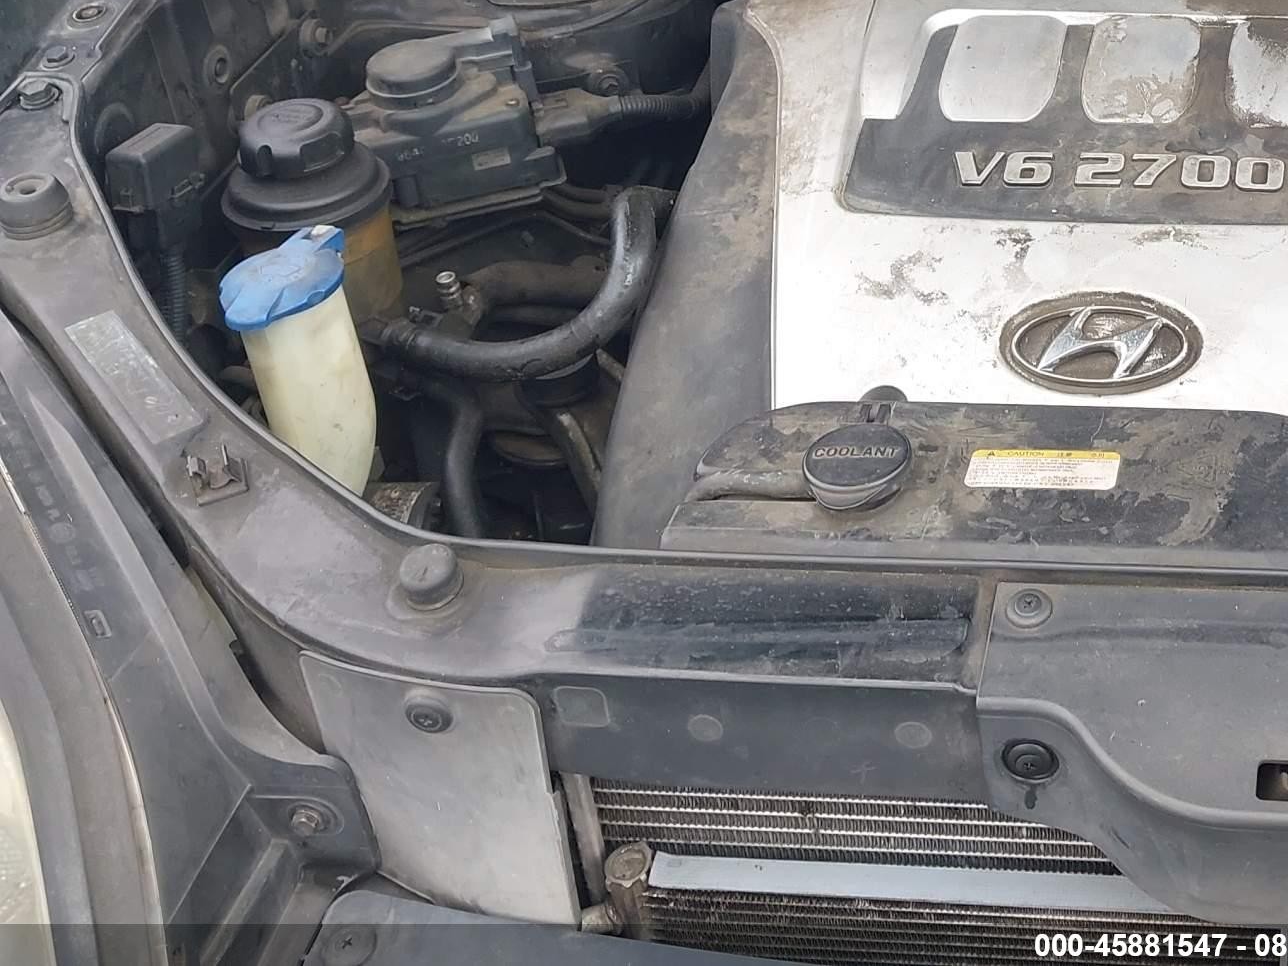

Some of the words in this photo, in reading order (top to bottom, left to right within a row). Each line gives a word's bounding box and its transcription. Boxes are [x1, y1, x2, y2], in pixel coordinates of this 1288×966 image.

[953, 150, 1054, 189] V6
[1074, 151, 1286, 192] 2700
[811, 444, 899, 460] COOLANT
